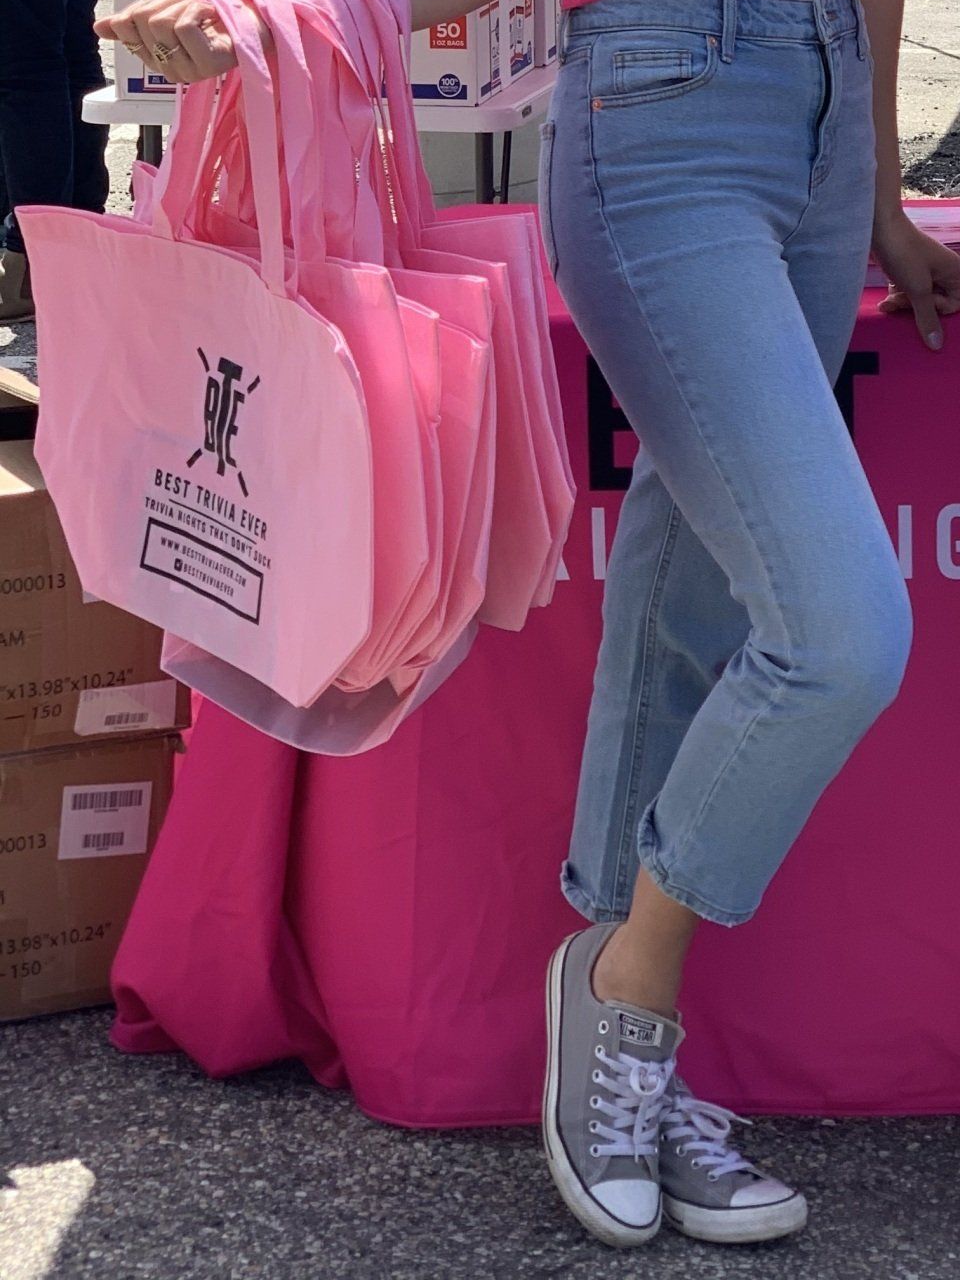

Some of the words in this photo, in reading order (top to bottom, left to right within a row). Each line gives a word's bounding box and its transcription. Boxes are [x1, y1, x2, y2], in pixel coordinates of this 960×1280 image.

[437, 23, 460, 38] 50
[204, 357, 245, 477] BTE
[155, 469, 191, 498] BEST
[197, 485, 235, 522] TRIVIA
[241, 509, 267, 541] EVER
[145, 497, 174, 518] TRIVIA
[178, 510, 206, 533] NIGHTS
[210, 525, 229, 544] THAT
[231, 537, 252, 557] DON'T
[254, 551, 271, 570] SUCK
[161, 537, 247, 588] WWW.BESTTRIVIAEVER.COM
[184, 563, 234, 597] BESTTRIVIAEVER
[32, 704, 62, 720] 150
[12, 961, 41, 978] 150
